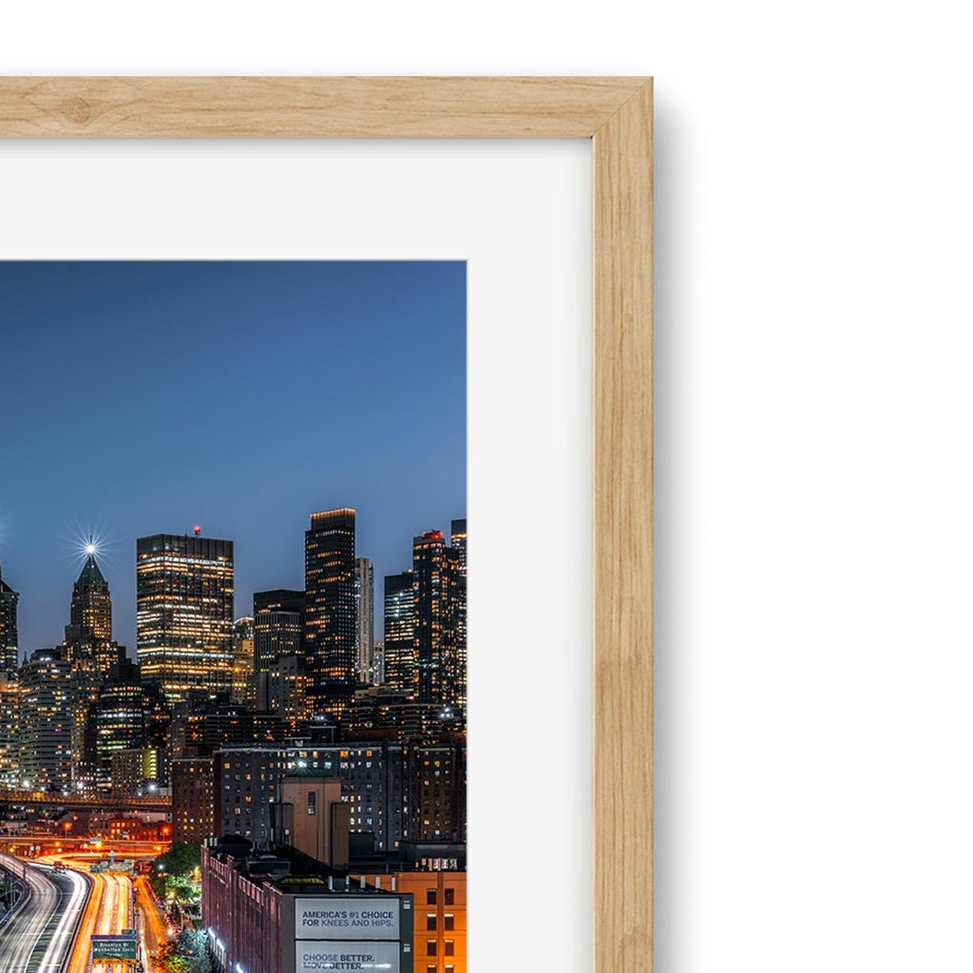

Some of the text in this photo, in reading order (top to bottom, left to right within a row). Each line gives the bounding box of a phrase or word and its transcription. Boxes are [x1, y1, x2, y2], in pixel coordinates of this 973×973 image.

[302, 911, 394, 919] AMERICA'S #1 CHOICE
[302, 919, 394, 927] FOR KNEES AND HIPS.
[303, 954, 338, 962] CHOOSE
